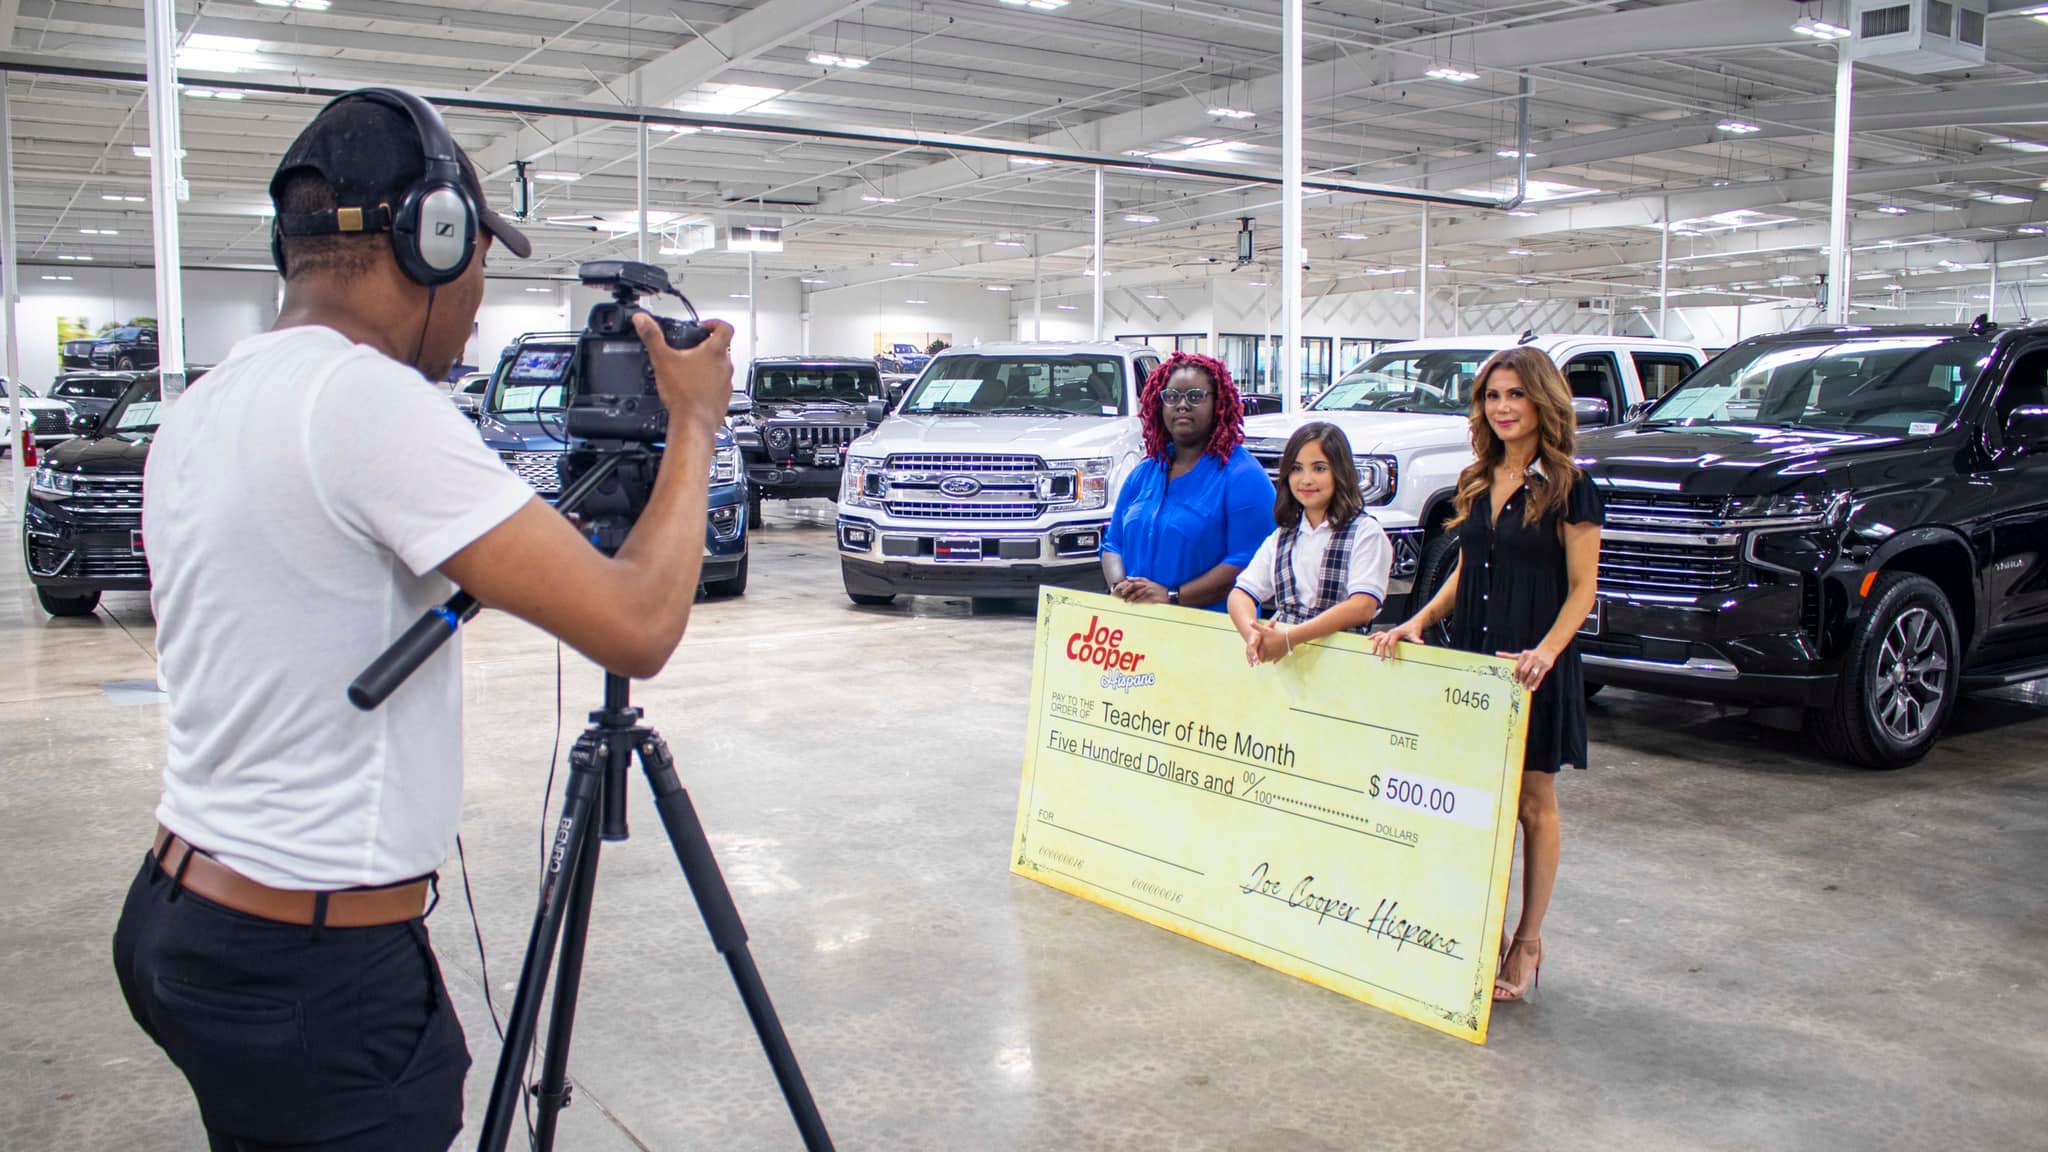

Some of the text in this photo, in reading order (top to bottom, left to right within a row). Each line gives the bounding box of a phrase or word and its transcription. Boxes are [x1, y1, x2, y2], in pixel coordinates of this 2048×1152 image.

[1083, 616, 1123, 648] Joe
[1067, 633, 1145, 672] Cooper
[1101, 669, 1155, 694] Hispano
[1051, 702, 1091, 719] ORDER OF
[1052, 692, 1095, 710] PAY TO THE
[1444, 687, 1490, 711] 10456
[1101, 701, 1295, 768] Teacher of the Month
[1390, 734, 1418, 751] DATE
[1049, 730, 1077, 753] Five
[1081, 738, 1142, 770] Hundred
[1146, 755, 1199, 786] Dollars
[1203, 774, 1235, 795] and
[1386, 777, 1455, 814] 500.00
[1038, 809, 1054, 821] FOR
[550, 817, 572, 873] BENRO
[1376, 823, 1418, 844] DOLLARS
[1243, 862, 1461, 952] Joe Cooper Hispano
